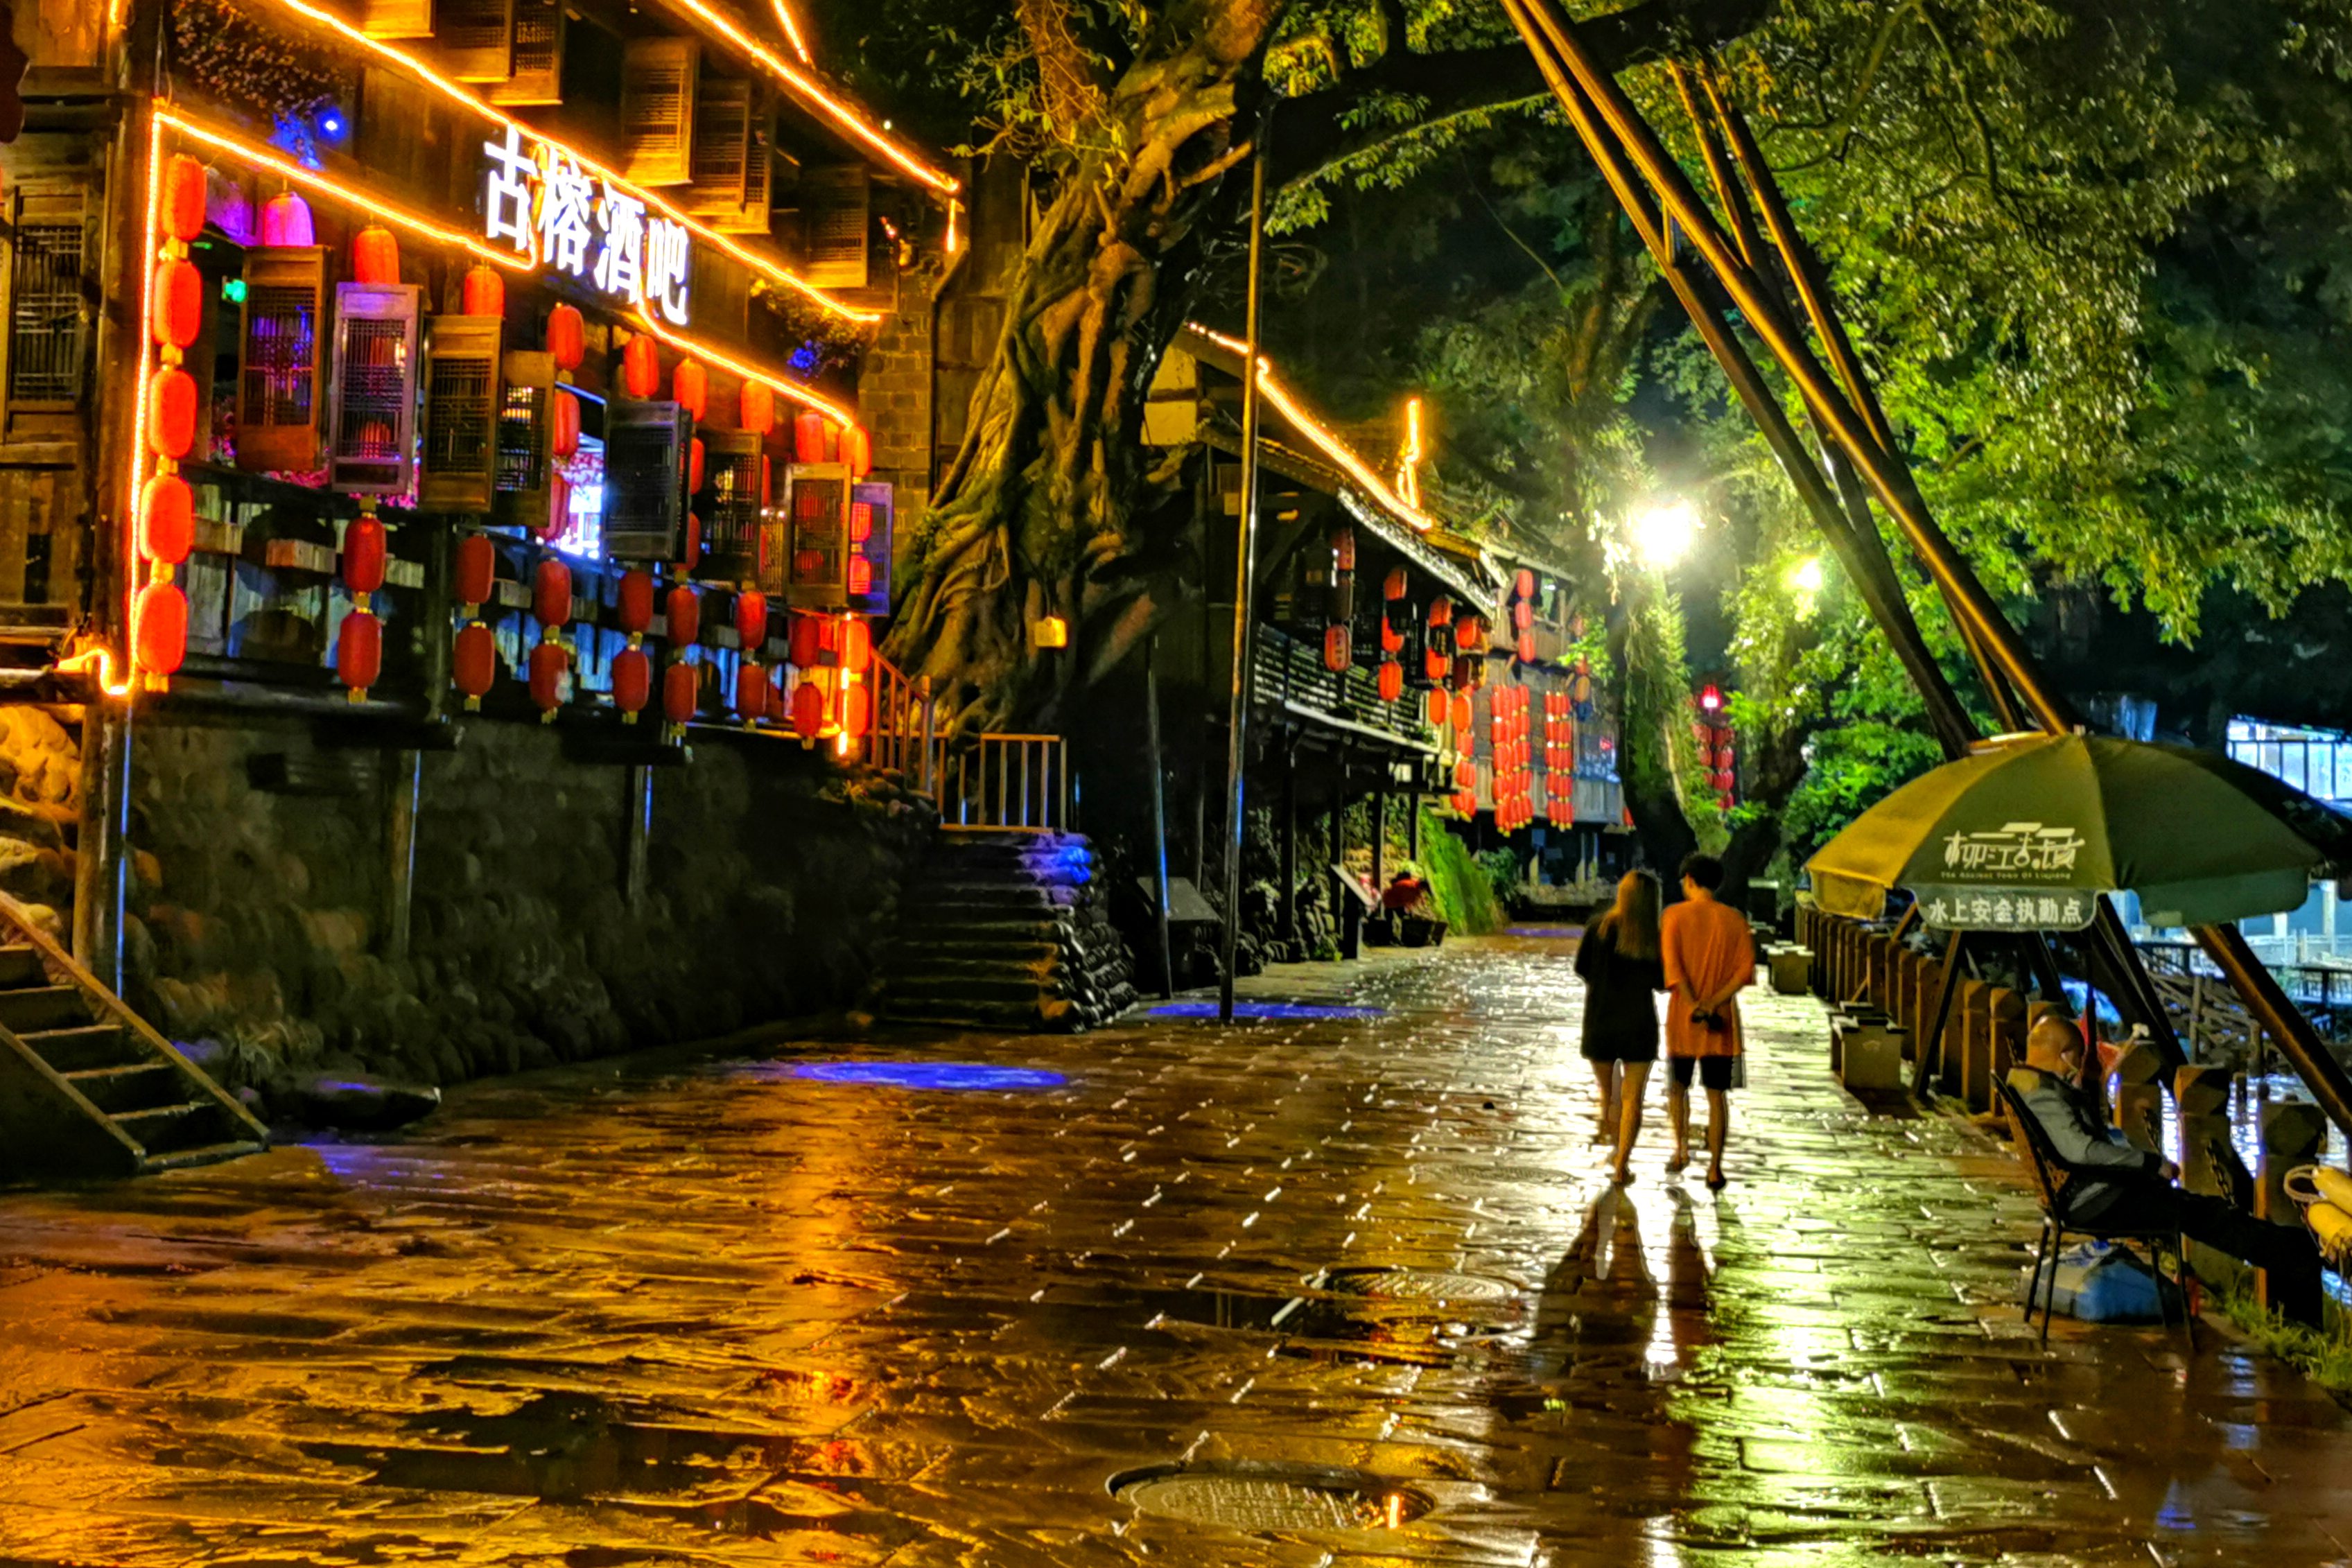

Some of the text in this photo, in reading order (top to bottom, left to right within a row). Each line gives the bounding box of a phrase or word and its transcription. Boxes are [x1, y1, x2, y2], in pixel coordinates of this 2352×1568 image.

[484, 124, 688, 325] 古榕酒吧
[1943, 822, 2085, 870] 柳江古镇
[1928, 897, 2082, 925] 水上安全执勤点
